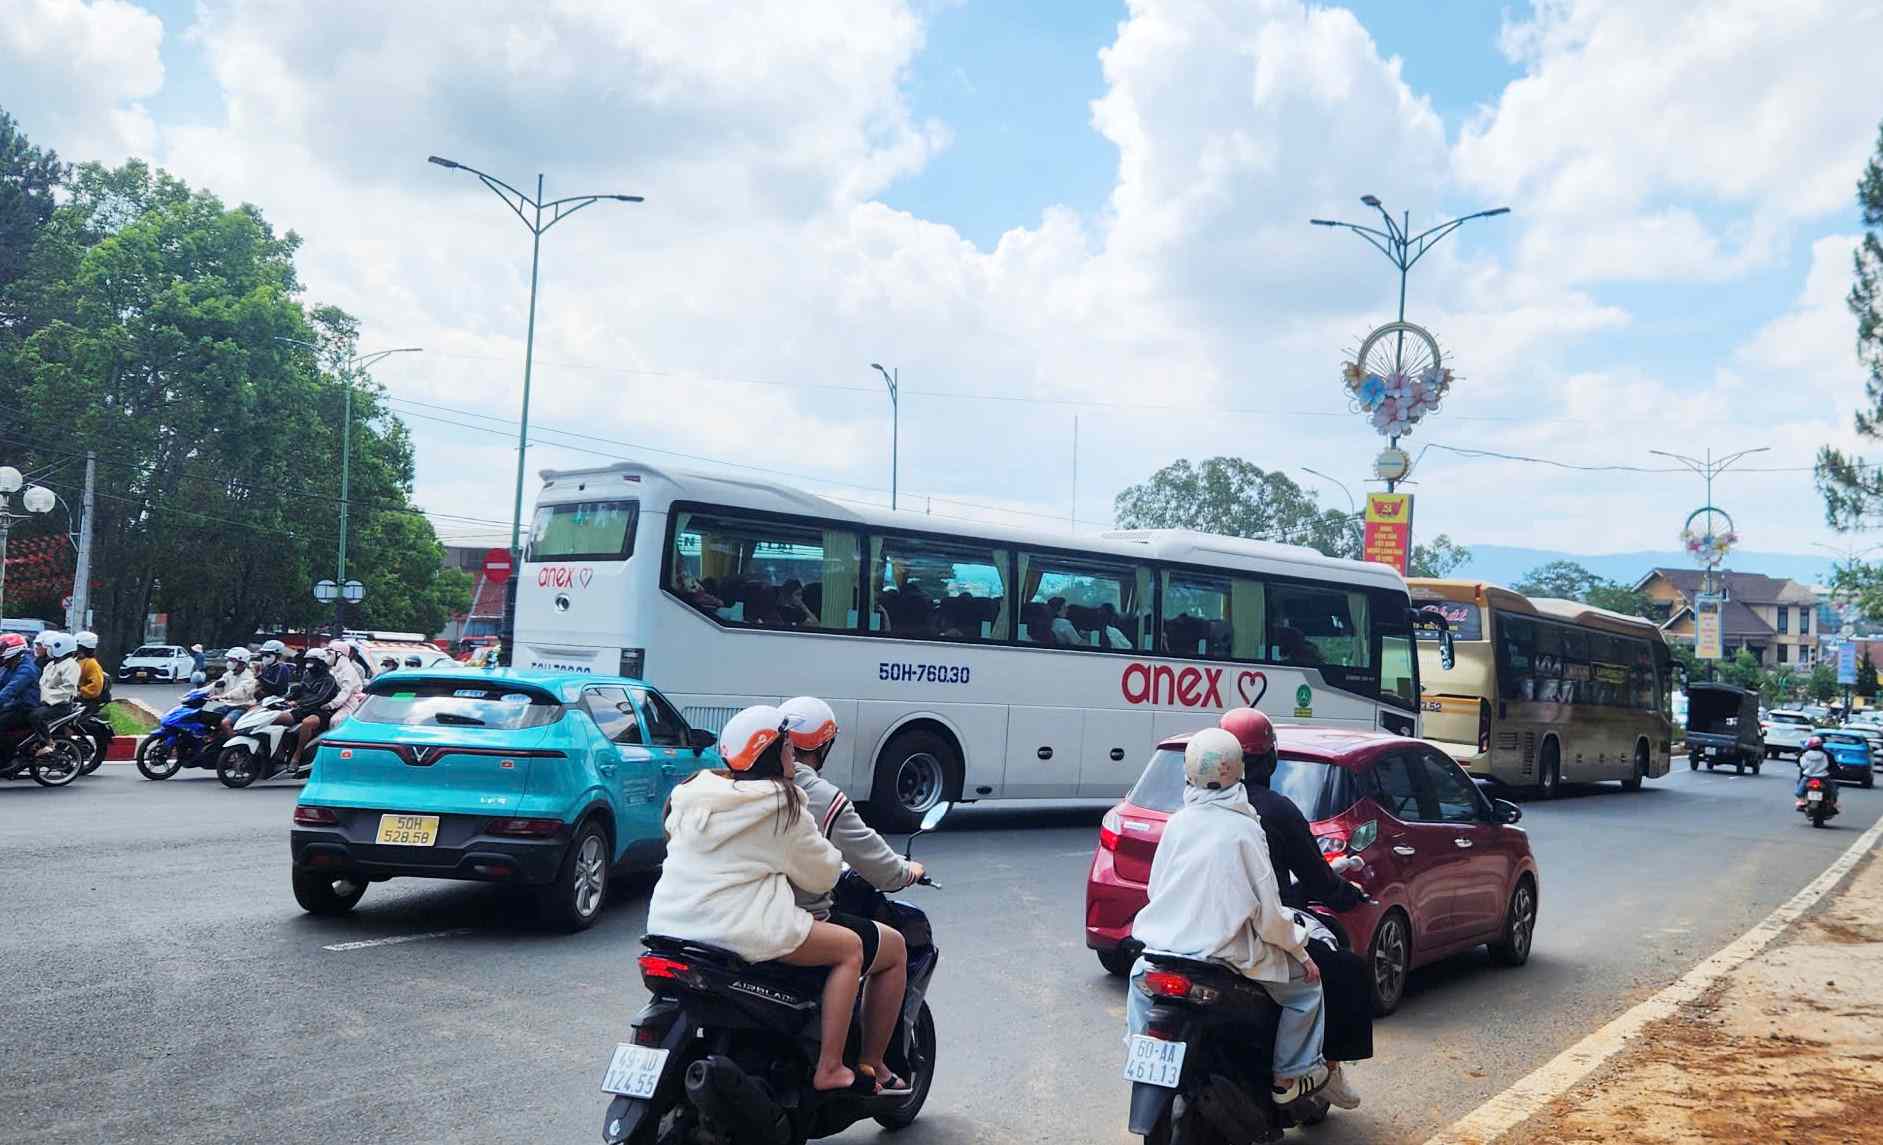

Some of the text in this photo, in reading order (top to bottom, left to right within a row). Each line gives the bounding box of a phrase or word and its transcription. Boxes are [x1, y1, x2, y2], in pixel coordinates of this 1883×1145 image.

[538, 567, 573, 588] anex
[879, 663, 970, 684] 50H-760.30
[1121, 662, 1224, 709] anex
[397, 817, 423, 831] 50H
[1137, 1040, 1176, 1064] 60-AA
[607, 1071, 656, 1094] 124.55
[1127, 1059, 1178, 1084] 461.13
